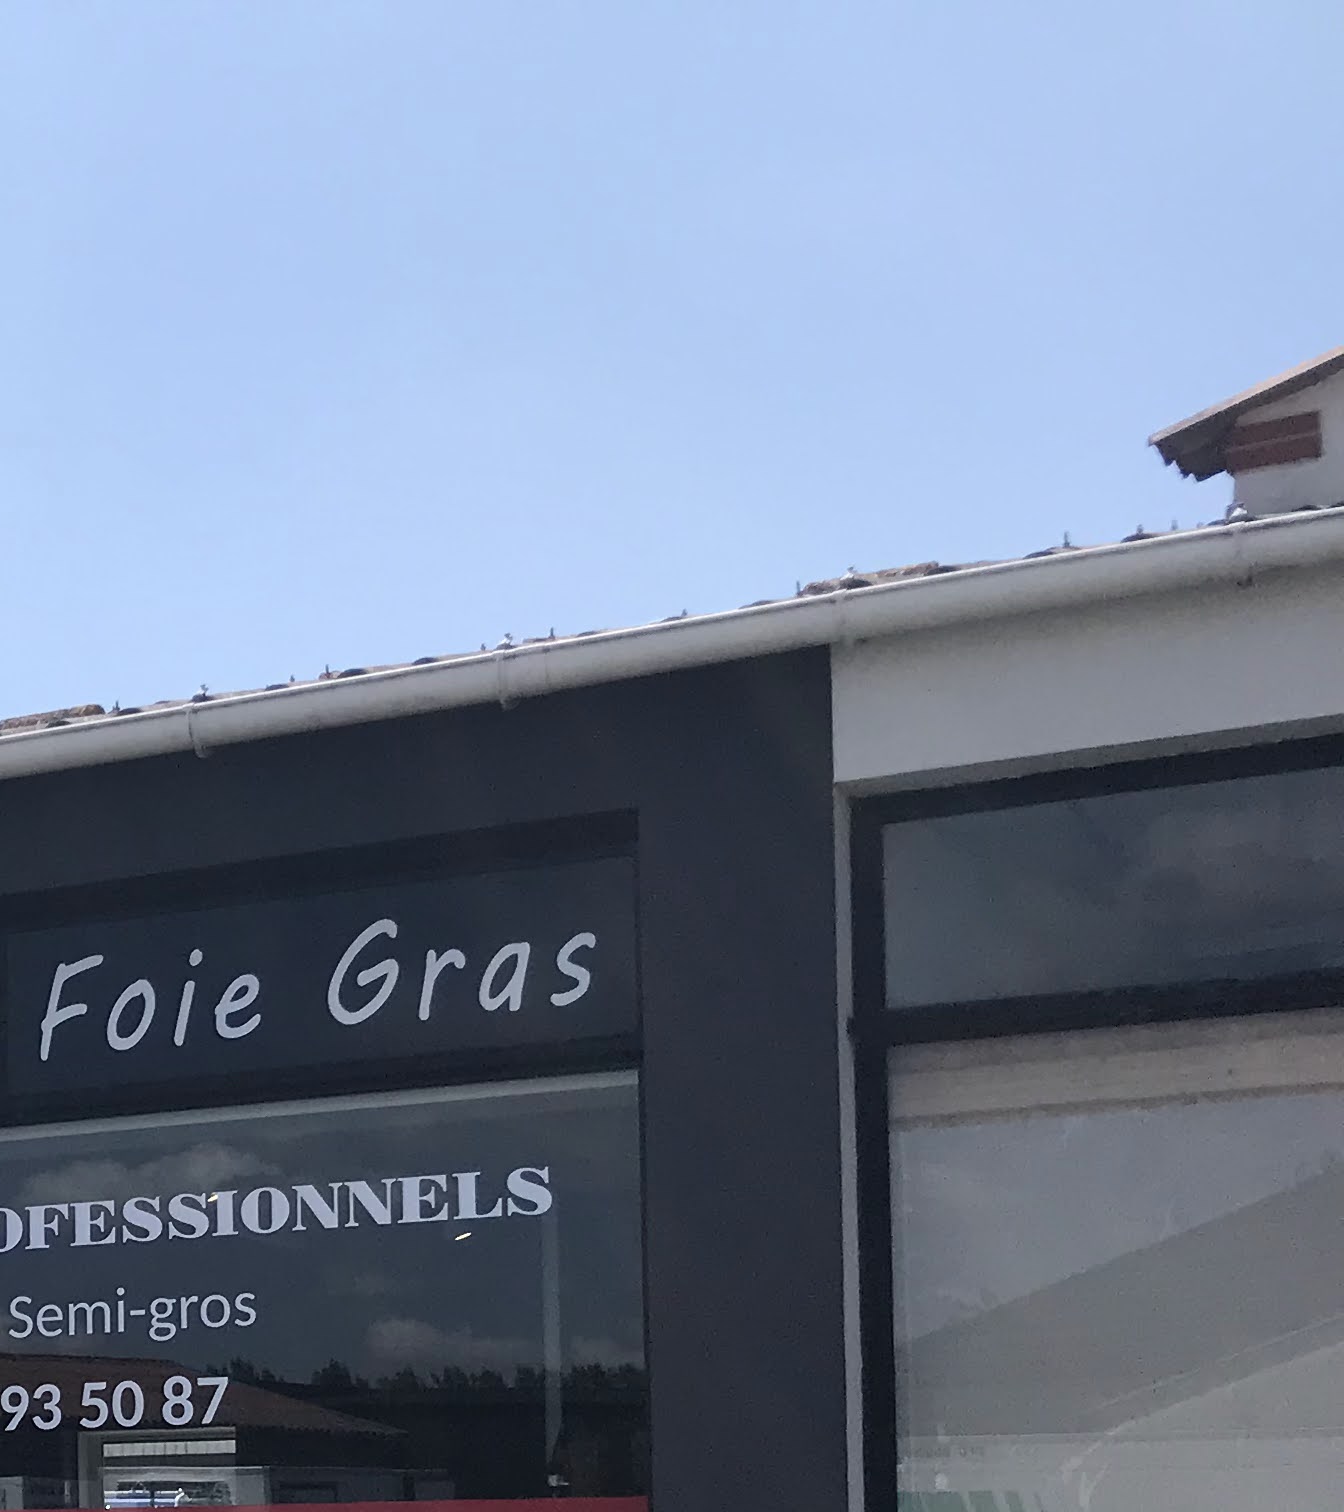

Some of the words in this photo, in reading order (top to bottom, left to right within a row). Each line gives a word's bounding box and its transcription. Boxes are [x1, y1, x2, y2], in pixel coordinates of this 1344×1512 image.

[41, 949, 261, 1061] Foie
[328, 919, 596, 1025] Gras
[9, 1288, 256, 1341] Semi-gros
[1, 1384, 61, 1431] 93
[80, 1381, 144, 1428] 50
[162, 1376, 229, 1428] 87
